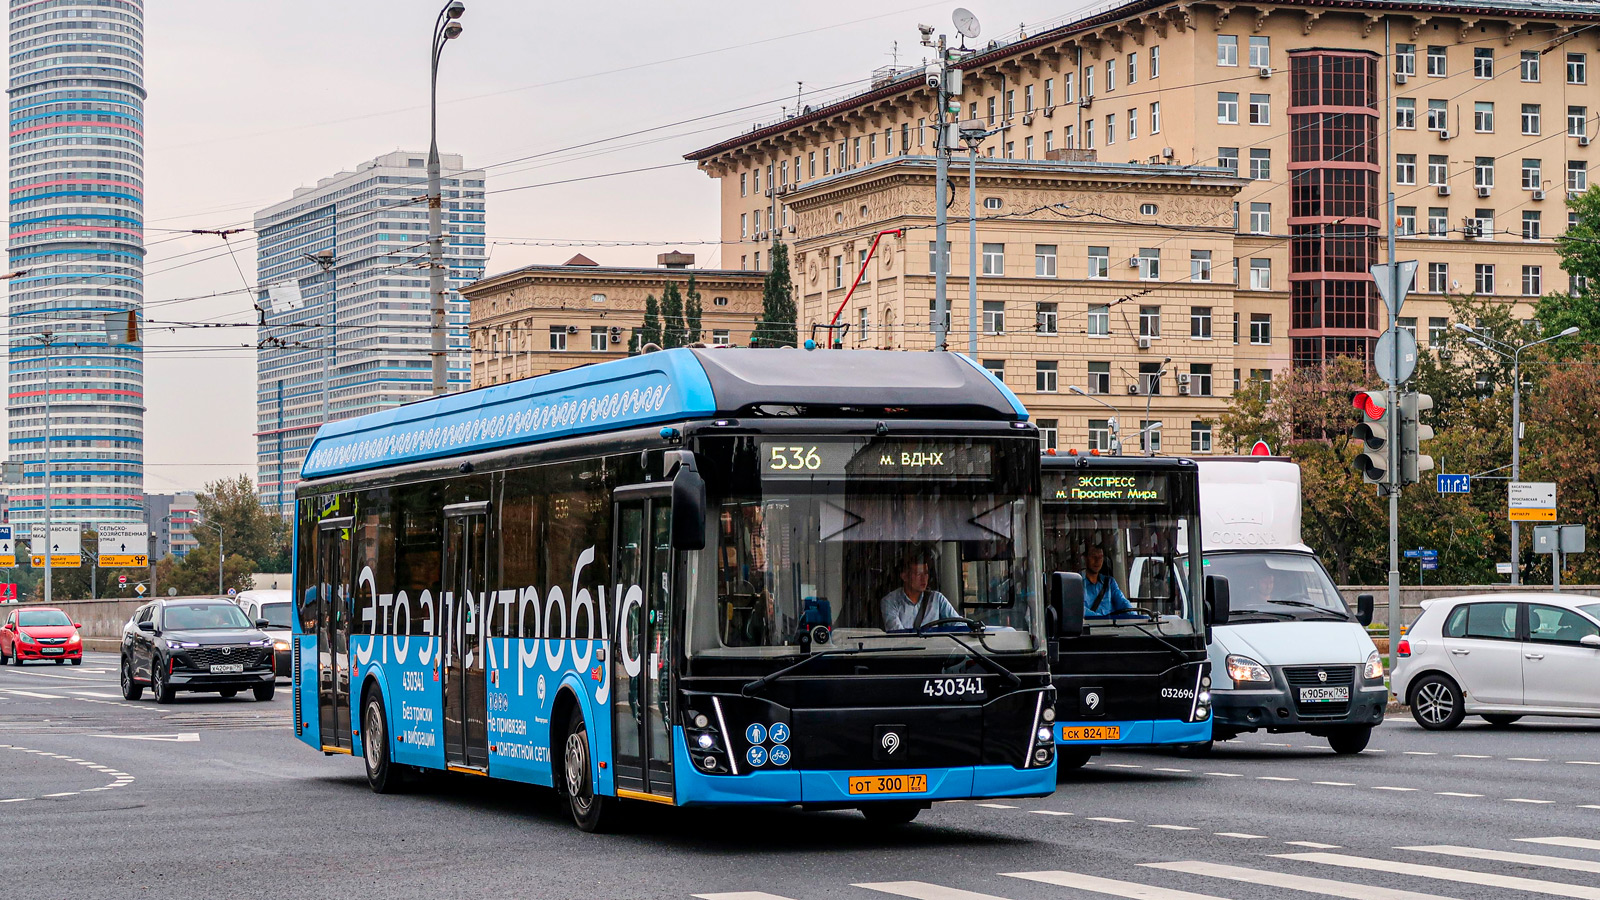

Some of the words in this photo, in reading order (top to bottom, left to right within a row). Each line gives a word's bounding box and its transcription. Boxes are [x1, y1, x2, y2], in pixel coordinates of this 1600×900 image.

[770, 446, 821, 470] 536
[880, 455, 895, 466] м.
[901, 452, 944, 467] ВДНХ
[1078, 476, 1136, 487] ЭКСПРЕСС
[1056, 490, 1068, 498] м.
[1071, 488, 1122, 500] Проспект
[1127, 488, 1157, 500] Мира
[1210, 532, 1280, 545] CORONA
[356, 566, 411, 666] Это
[402, 672, 424, 692] 430341
[923, 678, 984, 696] 430341
[1161, 688, 1194, 698] 032696
[1302, 688, 1334, 698] К905РК
[402, 700, 413, 720] Без
[413, 706, 432, 724] тряски
[487, 712, 496, 732] Не
[497, 718, 526, 737] привязан
[1068, 730, 1080, 738] СК
[1083, 728, 1102, 738] 824
[1107, 728, 1117, 736] 77
[408, 726, 435, 749] вибраций
[496, 740, 534, 760] контактной
[534, 746, 551, 762] сети
[856, 781, 871, 792] ОТ
[878, 778, 902, 790] 300
[910, 776, 922, 786] 77
